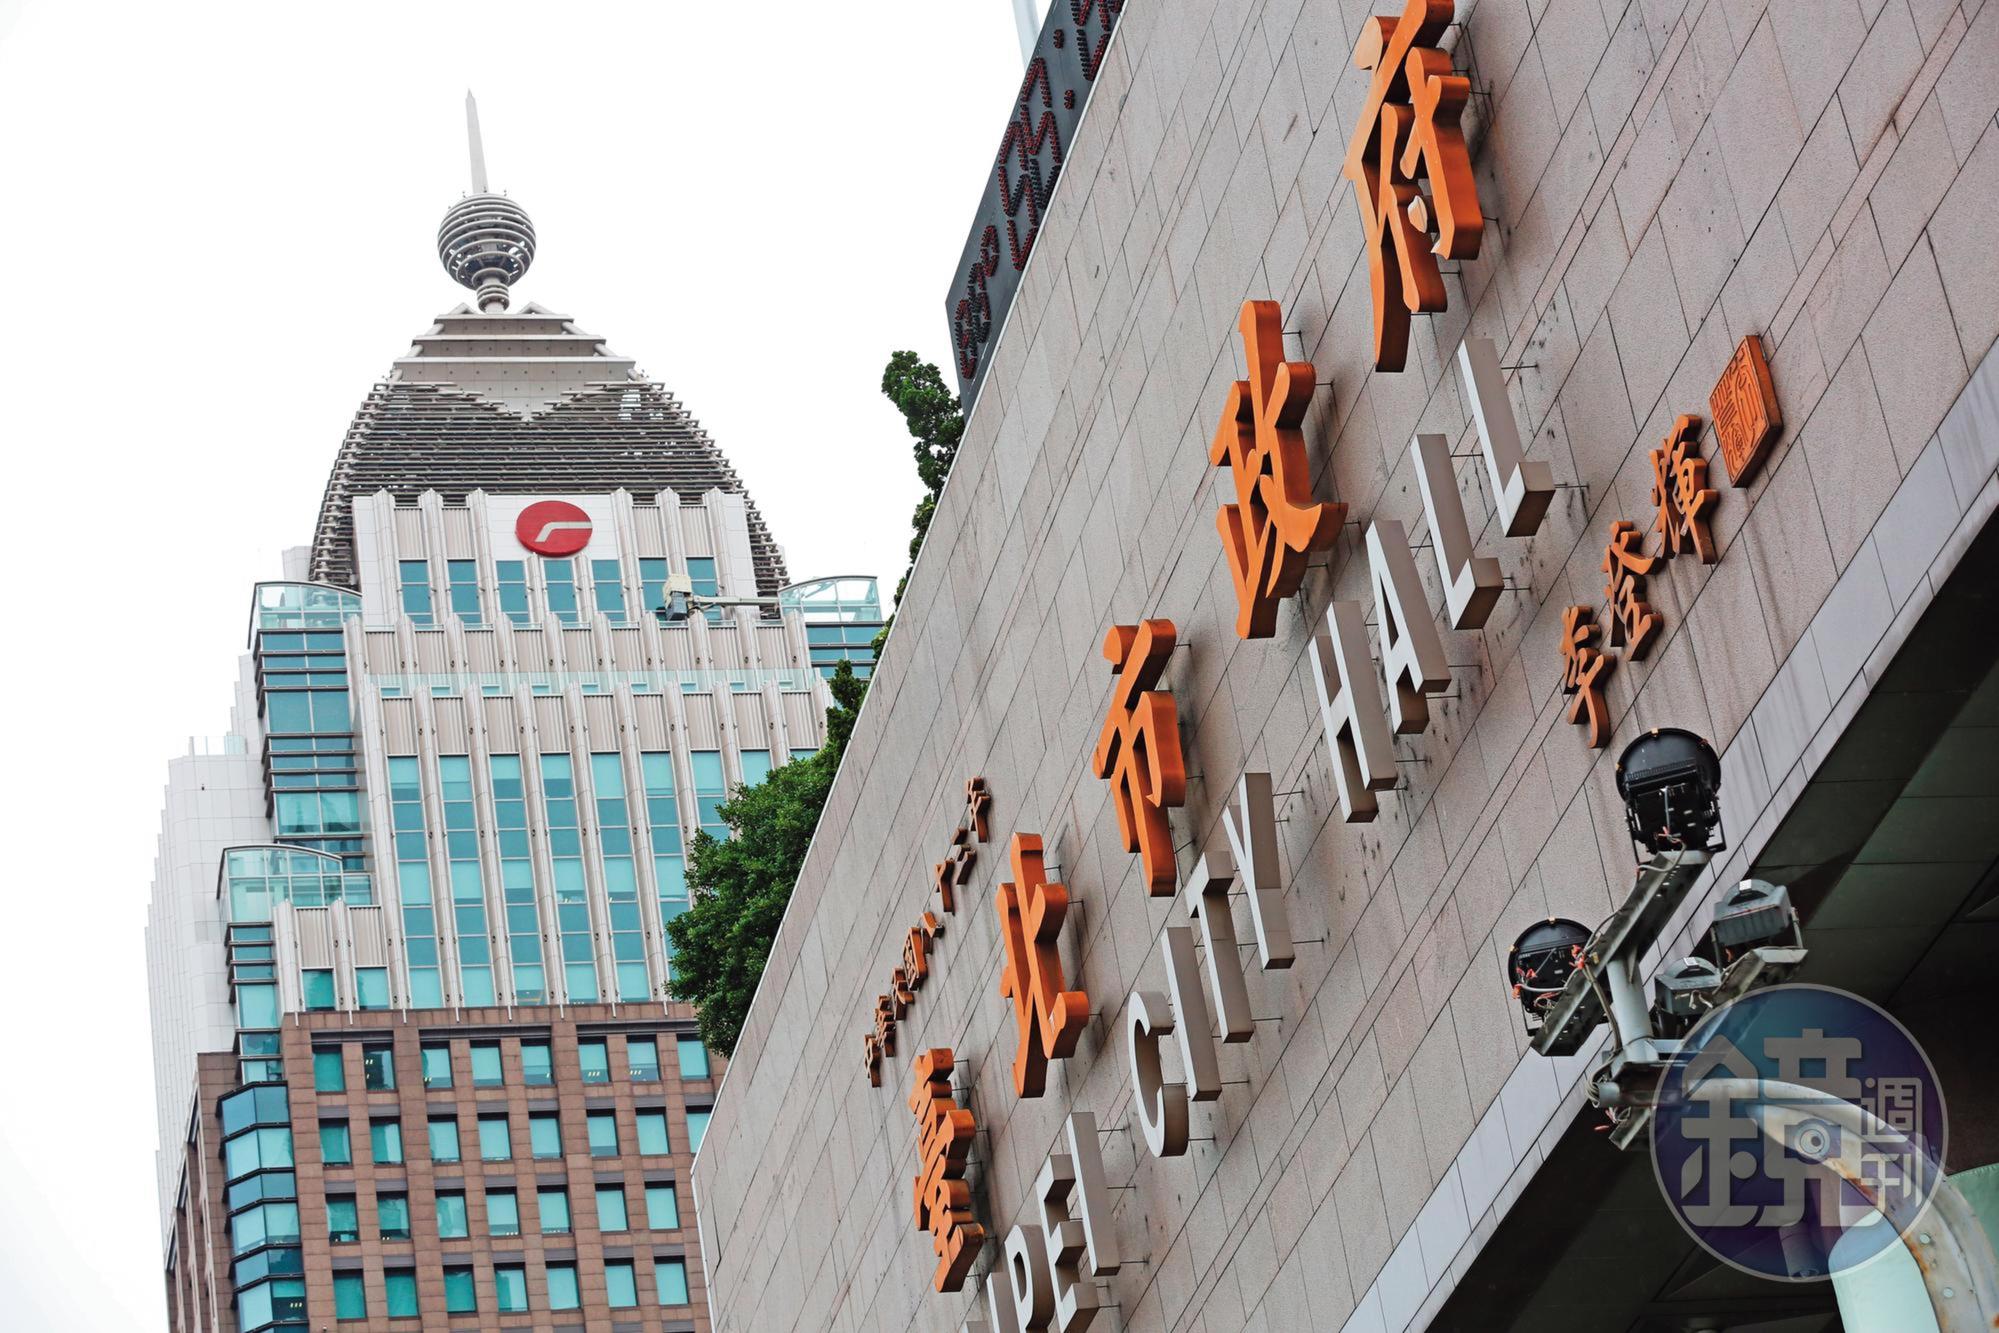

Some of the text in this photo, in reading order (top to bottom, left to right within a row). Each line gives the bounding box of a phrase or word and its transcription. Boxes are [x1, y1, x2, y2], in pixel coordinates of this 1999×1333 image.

[966, 338, 1556, 1333] PEI CITY HALL
